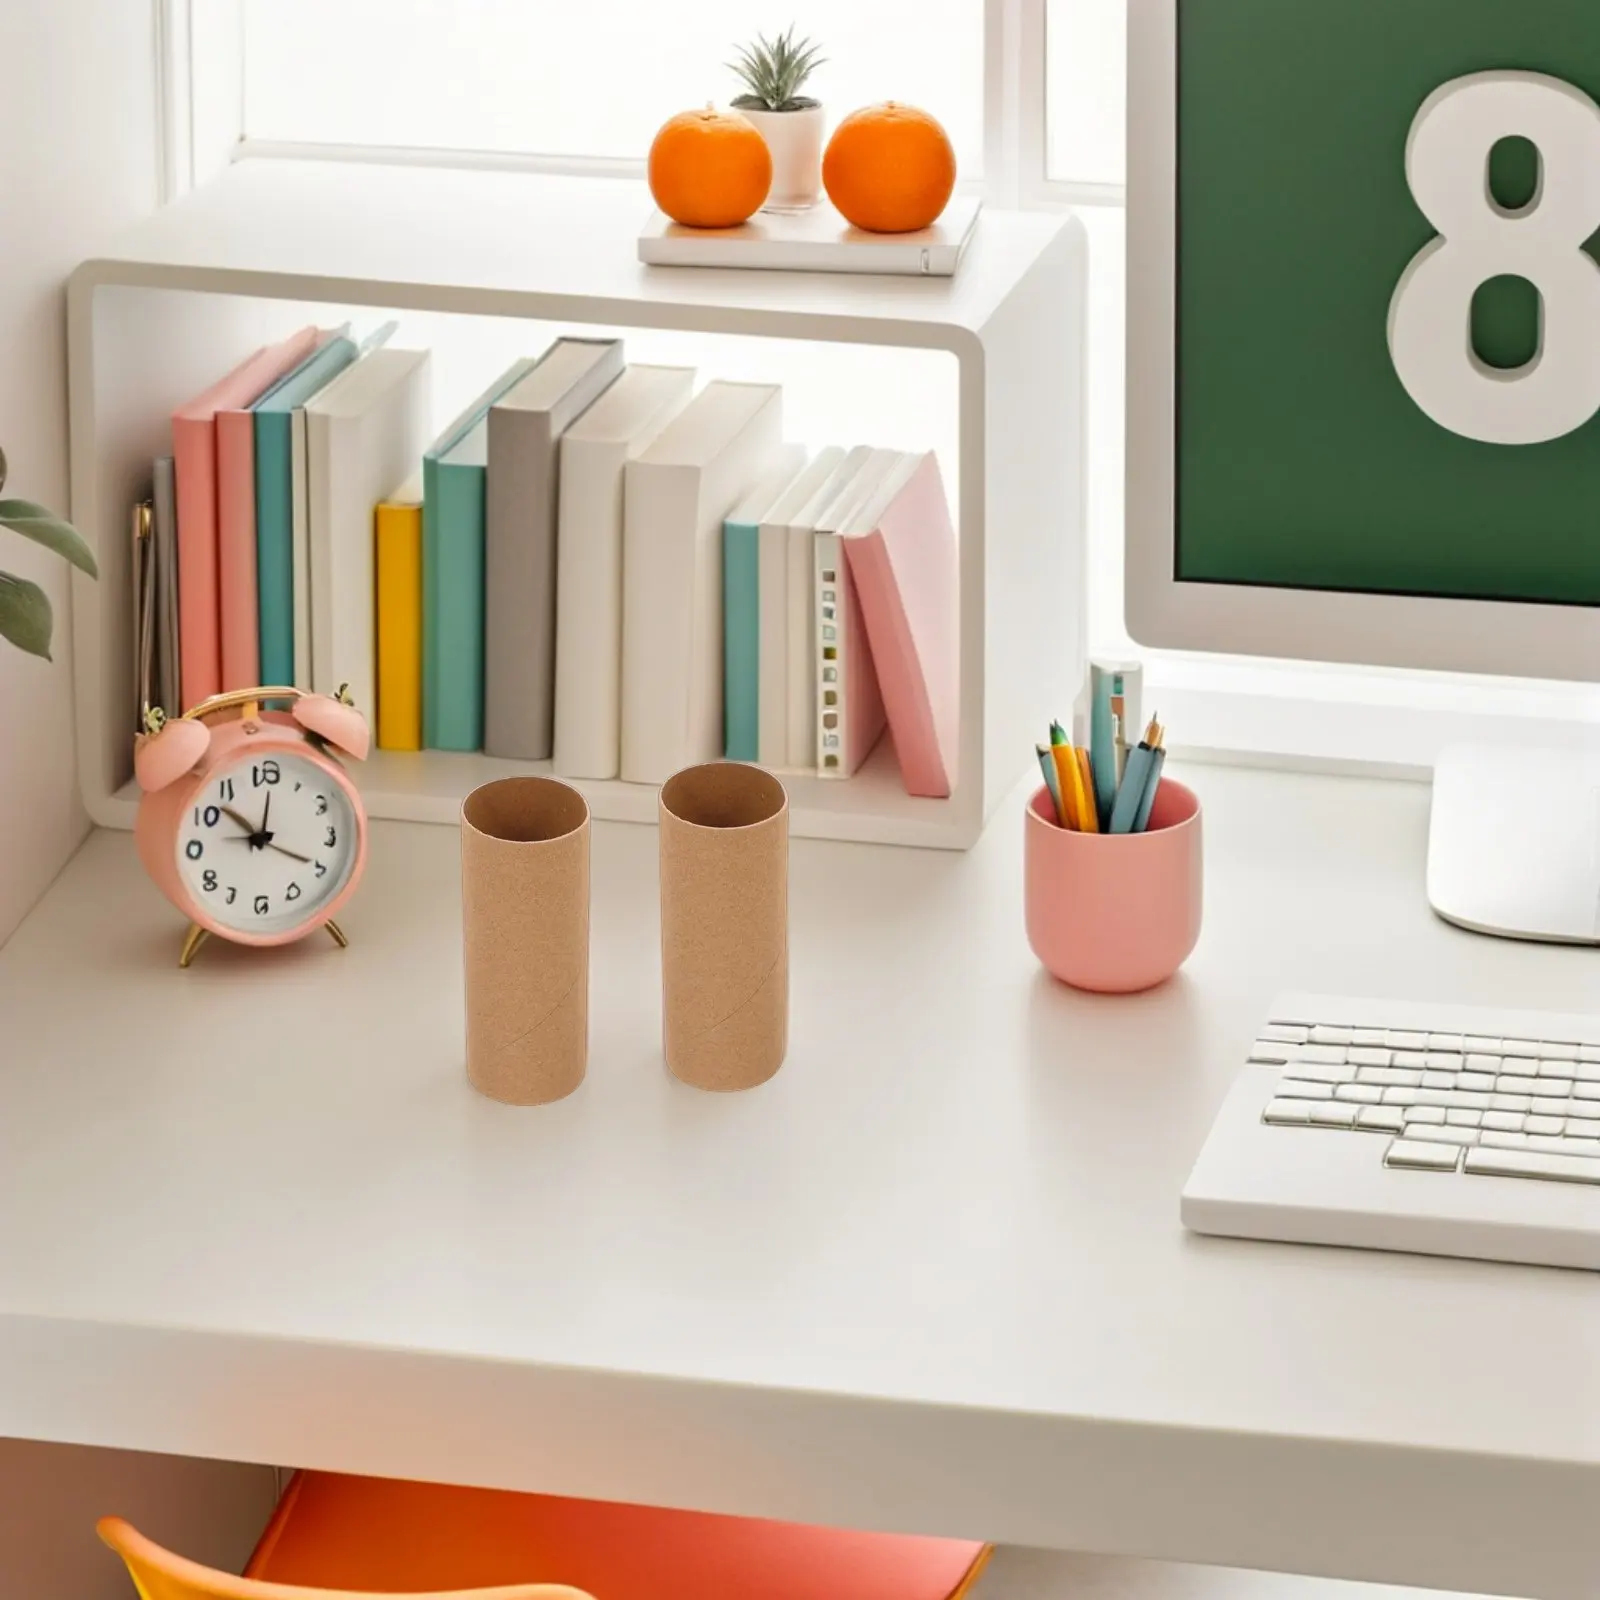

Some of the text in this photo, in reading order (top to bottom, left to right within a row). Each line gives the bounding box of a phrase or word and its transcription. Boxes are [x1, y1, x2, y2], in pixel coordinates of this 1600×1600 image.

[1387, 69, 1600, 445] 8
[194, 806, 220, 827] 10
[202, 869, 218, 891] 8
